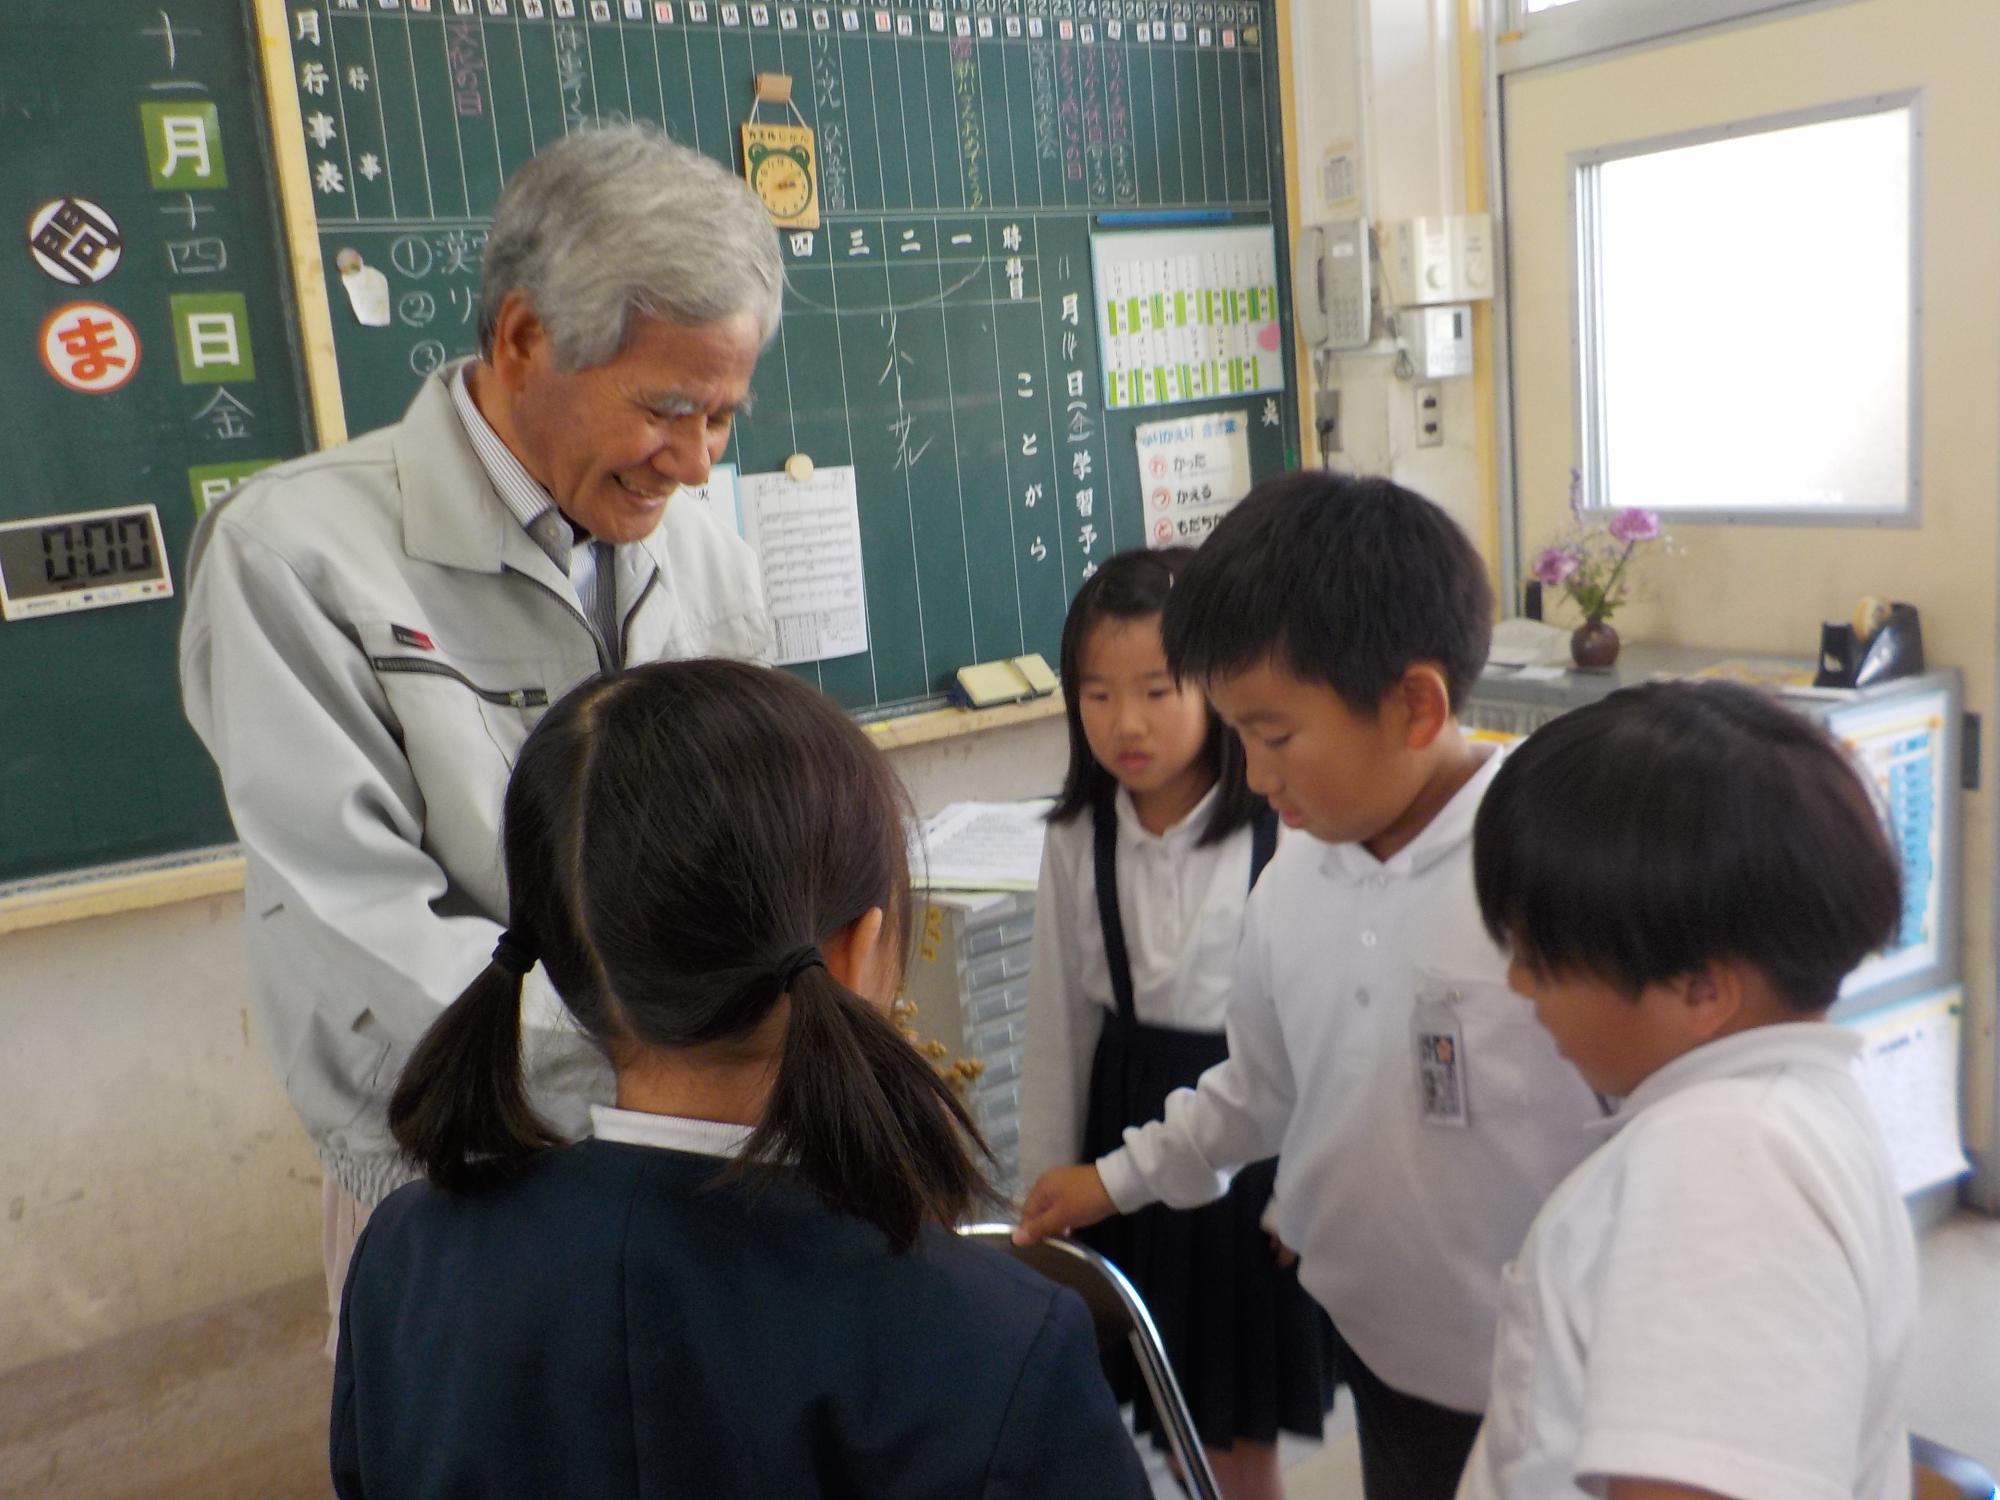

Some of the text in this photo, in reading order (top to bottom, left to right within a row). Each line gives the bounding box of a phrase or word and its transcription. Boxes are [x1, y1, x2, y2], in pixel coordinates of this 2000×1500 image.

[848, 228, 870, 256] 三
[901, 229, 921, 252] 二
[57, 317, 127, 381] ま
[1018, 372, 1047, 562] ことがら
[42, 516, 150, 583] 0:00
